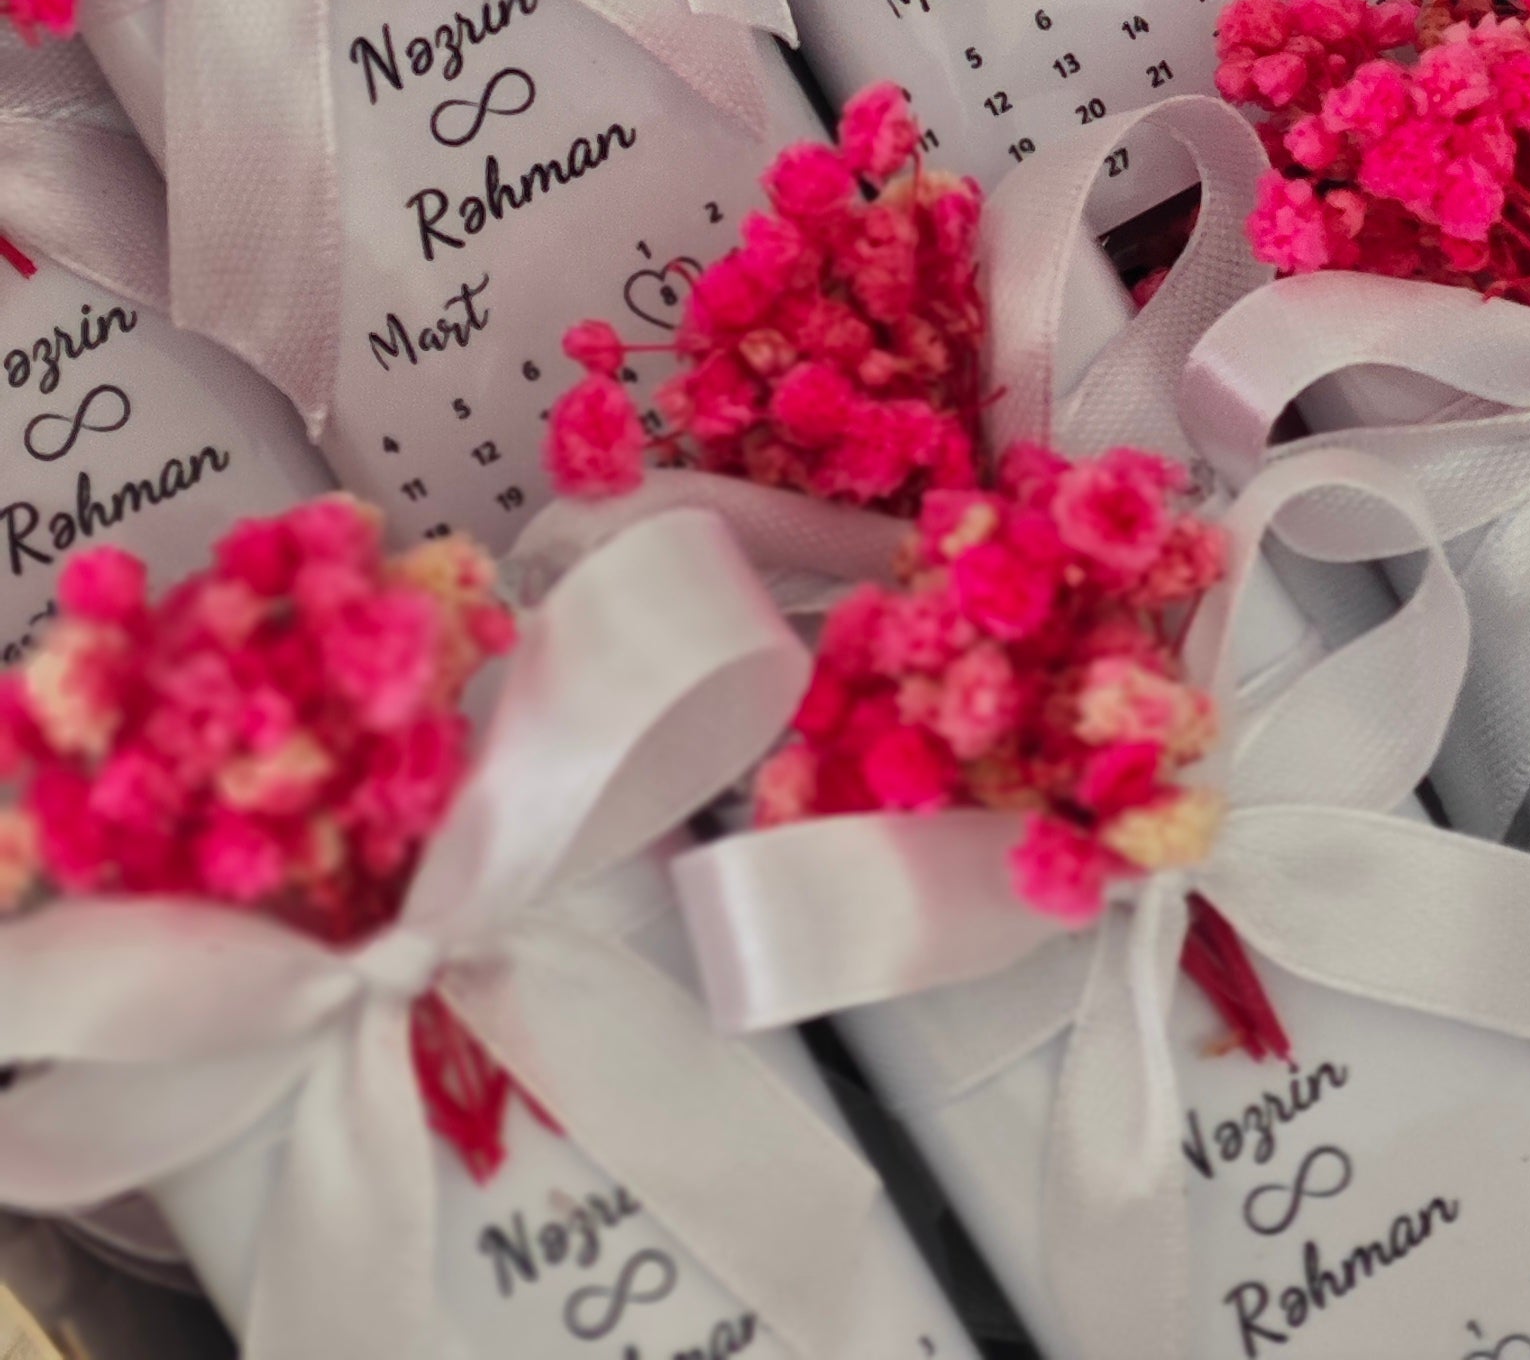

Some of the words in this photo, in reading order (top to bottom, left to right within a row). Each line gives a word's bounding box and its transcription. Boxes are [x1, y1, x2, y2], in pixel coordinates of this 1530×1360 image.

[964, 47, 982, 69] 5
[1035, 9, 1053, 31] 6
[984, 91, 1013, 116] 12
[1052, 53, 1081, 79] 13
[1122, 16, 1149, 40] 14
[405, 123, 637, 261] Rəhman
[636, 241, 651, 259] 1
[705, 202, 723, 223] 2
[368, 273, 489, 371] Mart
[452, 398, 471, 420] 5
[522, 360, 540, 381] 6
[0, 446, 230, 576] Rəhman
[1224, 1197, 1459, 1360] Rəhman
